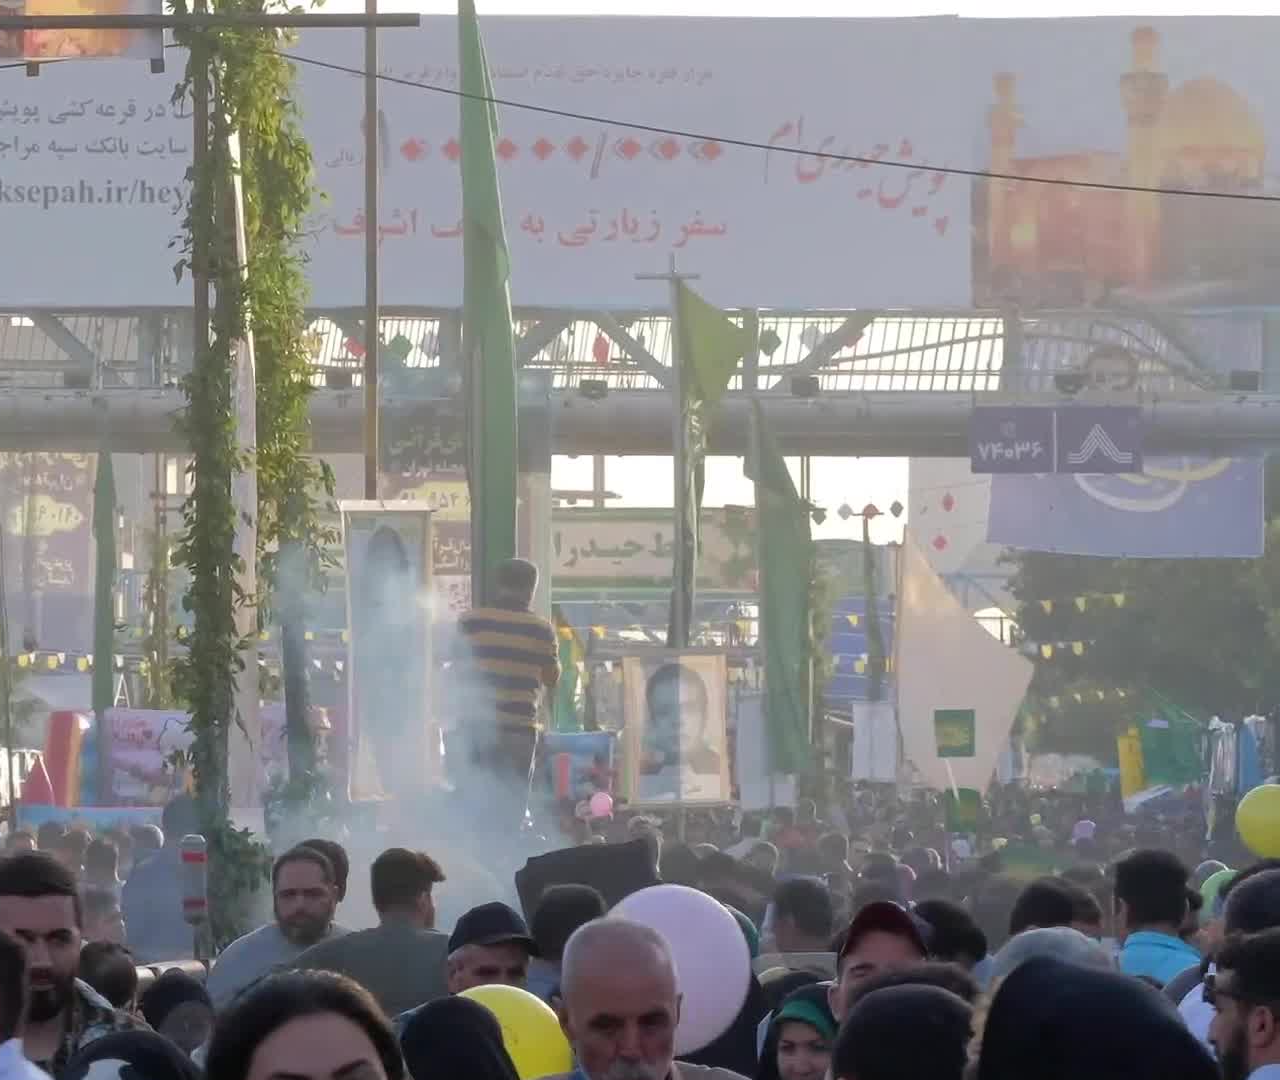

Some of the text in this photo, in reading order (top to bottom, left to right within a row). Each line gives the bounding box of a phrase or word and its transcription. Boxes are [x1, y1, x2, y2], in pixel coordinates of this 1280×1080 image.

[144, 104, 166, 122] در
[48, 140, 78, 159] سپه
[86, 136, 129, 157] بانک
[136, 136, 188, 157] سایت
[520, 210, 545, 234] به
[558, 208, 661, 247] زیارتی
[672, 210, 727, 248] سفر
[978, 441, 1044, 461] ۷۴۰۳۶
